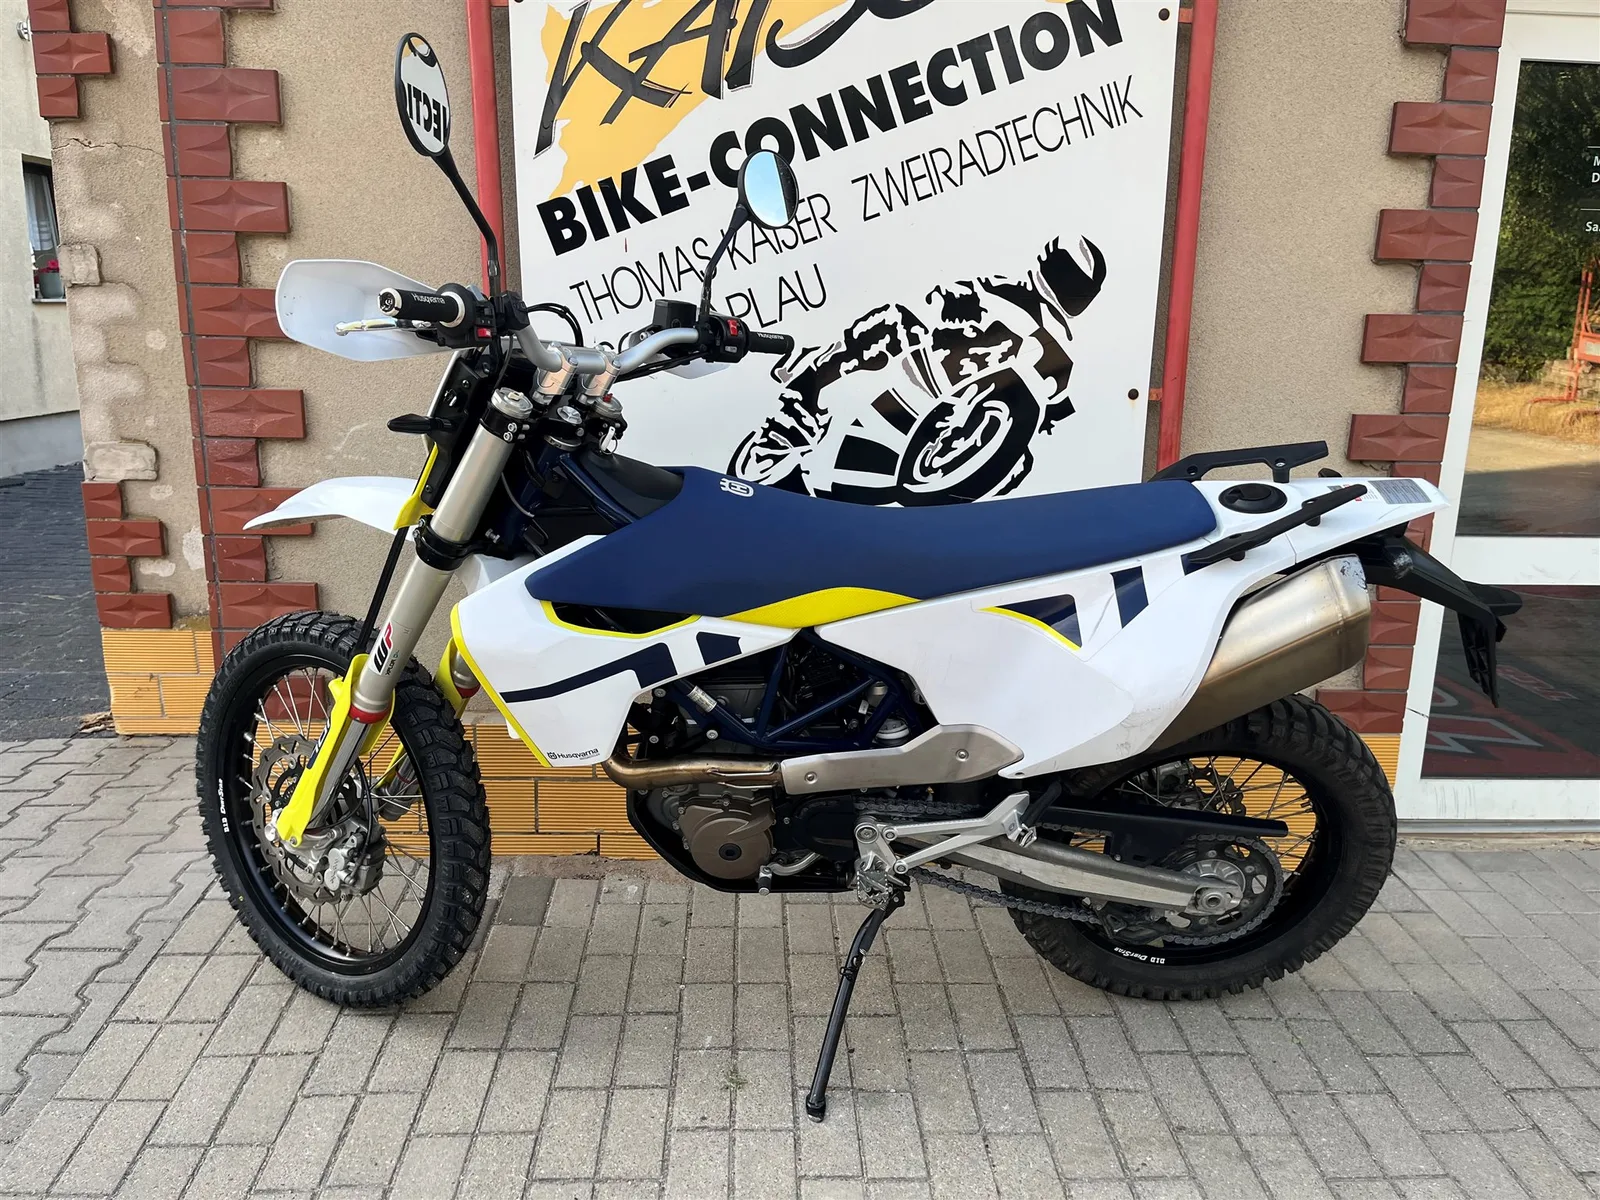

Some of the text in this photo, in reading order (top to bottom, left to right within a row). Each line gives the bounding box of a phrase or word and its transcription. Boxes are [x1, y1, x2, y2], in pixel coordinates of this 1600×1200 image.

[537, 0, 1123, 257] BIKE-CONNECTION
[569, 237, 718, 324] THOMAS
[851, 74, 1143, 222] ZWEIRADTECHNIK
[725, 263, 827, 328] PLAU
[373, 621, 394, 673] WP
[557, 748, 599, 759] Husqvarna
[1150, 956, 1166, 964] DID
